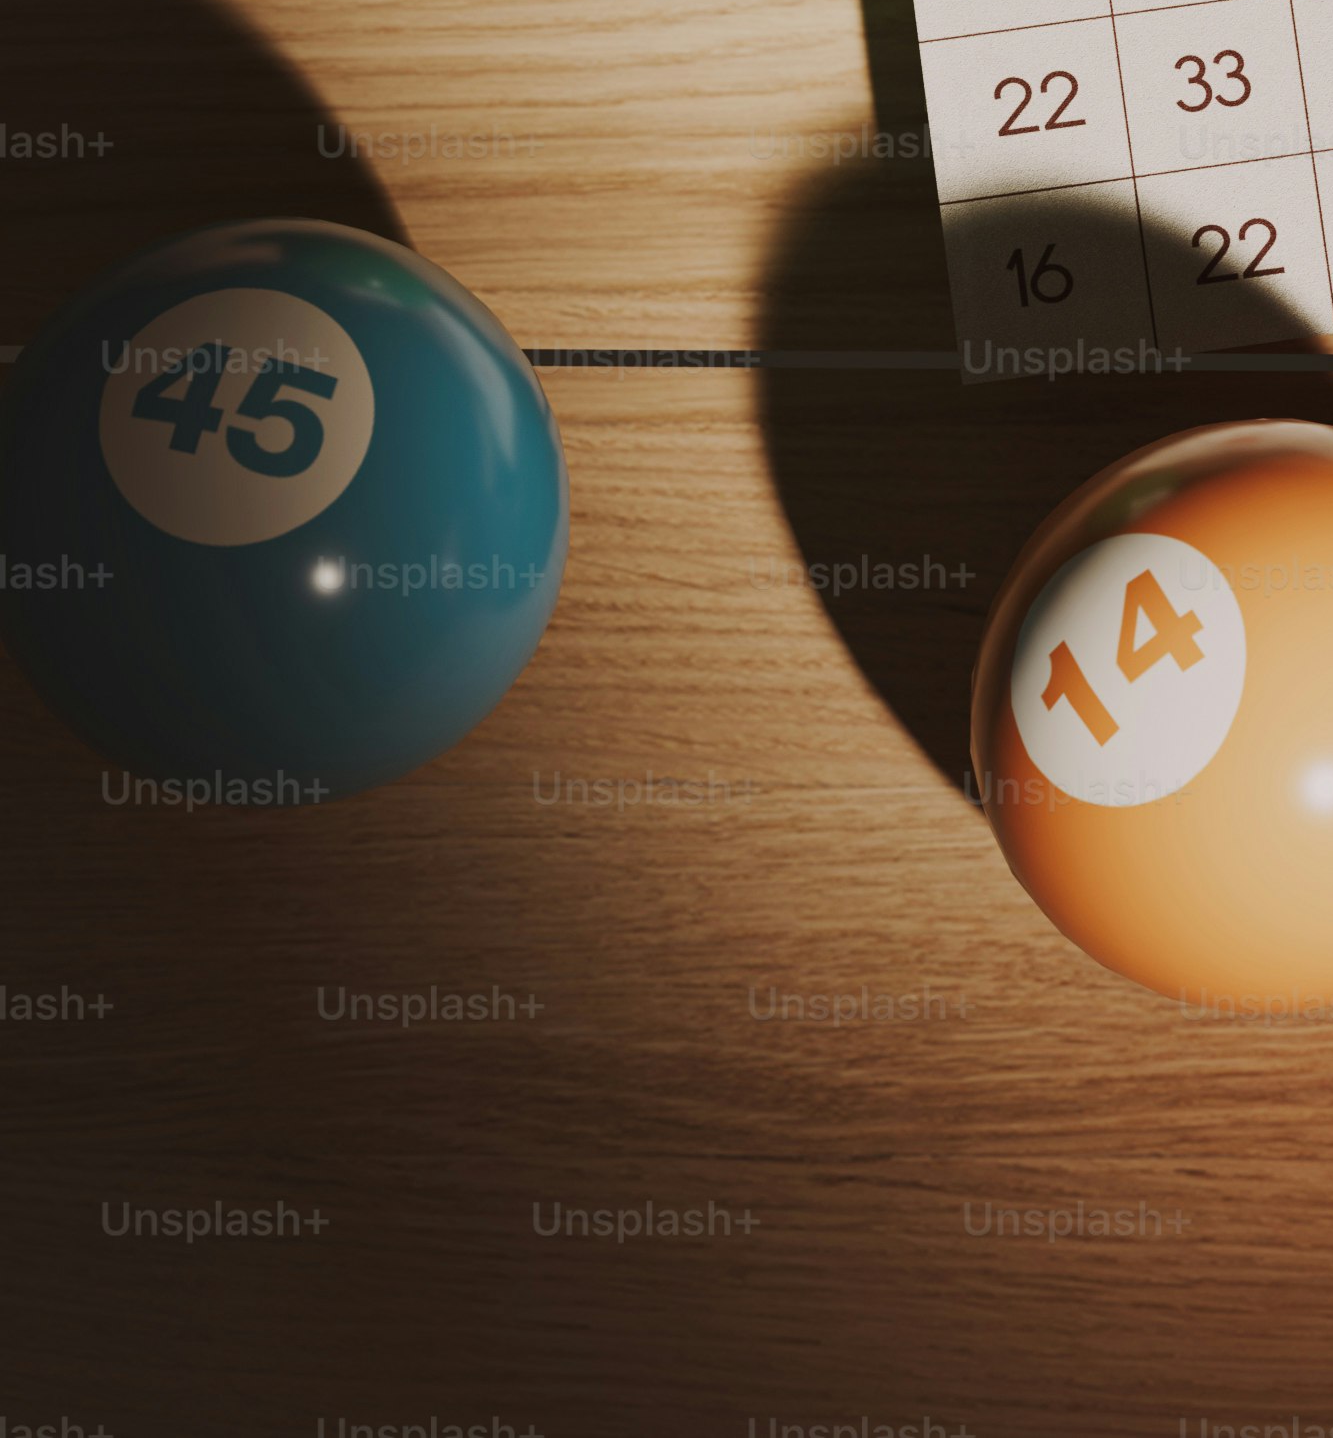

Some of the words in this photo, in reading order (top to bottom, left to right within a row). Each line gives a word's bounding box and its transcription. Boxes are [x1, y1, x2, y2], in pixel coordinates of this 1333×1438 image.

[994, 70, 1086, 137] 22
[1175, 49, 1251, 113] 33
[1006, 243, 1074, 307] 16
[1192, 219, 1286, 284] 22
[130, 342, 338, 478] 45
[1040, 568, 1206, 748] 14
